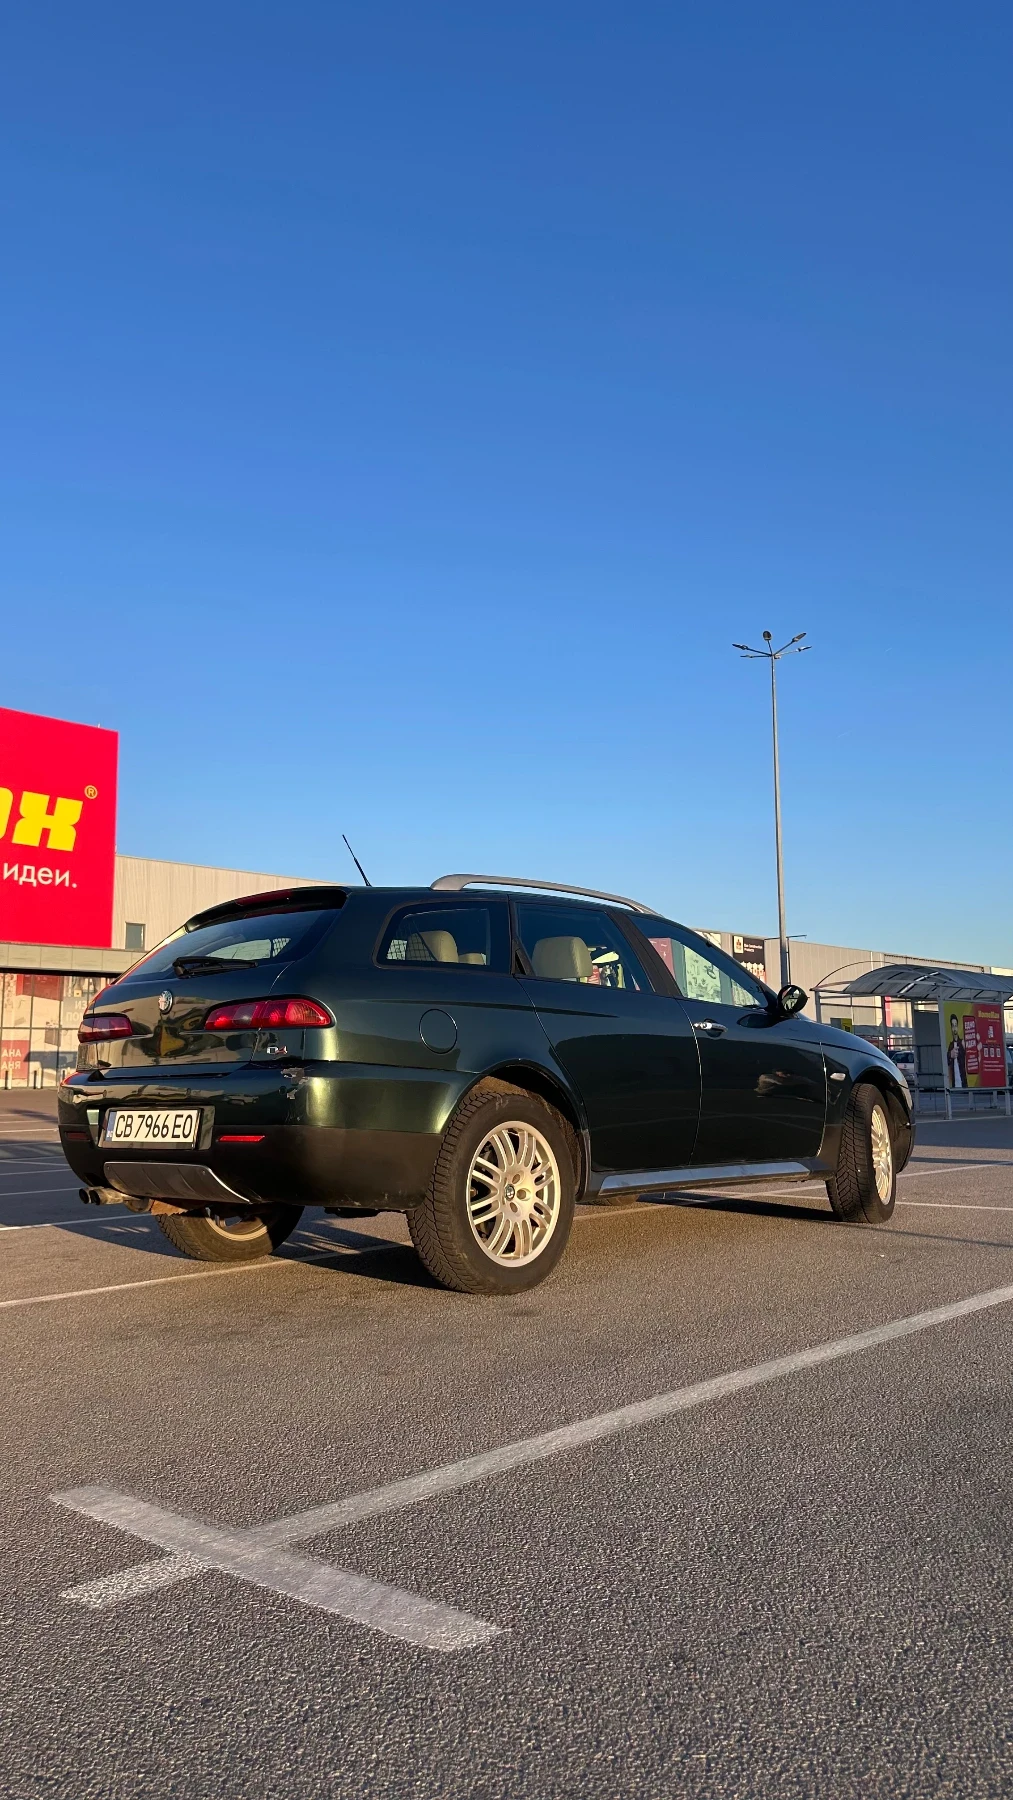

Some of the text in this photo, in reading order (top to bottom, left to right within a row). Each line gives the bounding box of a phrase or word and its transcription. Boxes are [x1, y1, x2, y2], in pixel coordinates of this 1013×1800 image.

[3, 862, 78, 889] идеи.
[115, 1114, 134, 1138] CB
[134, 1114, 170, 1139] 7966
